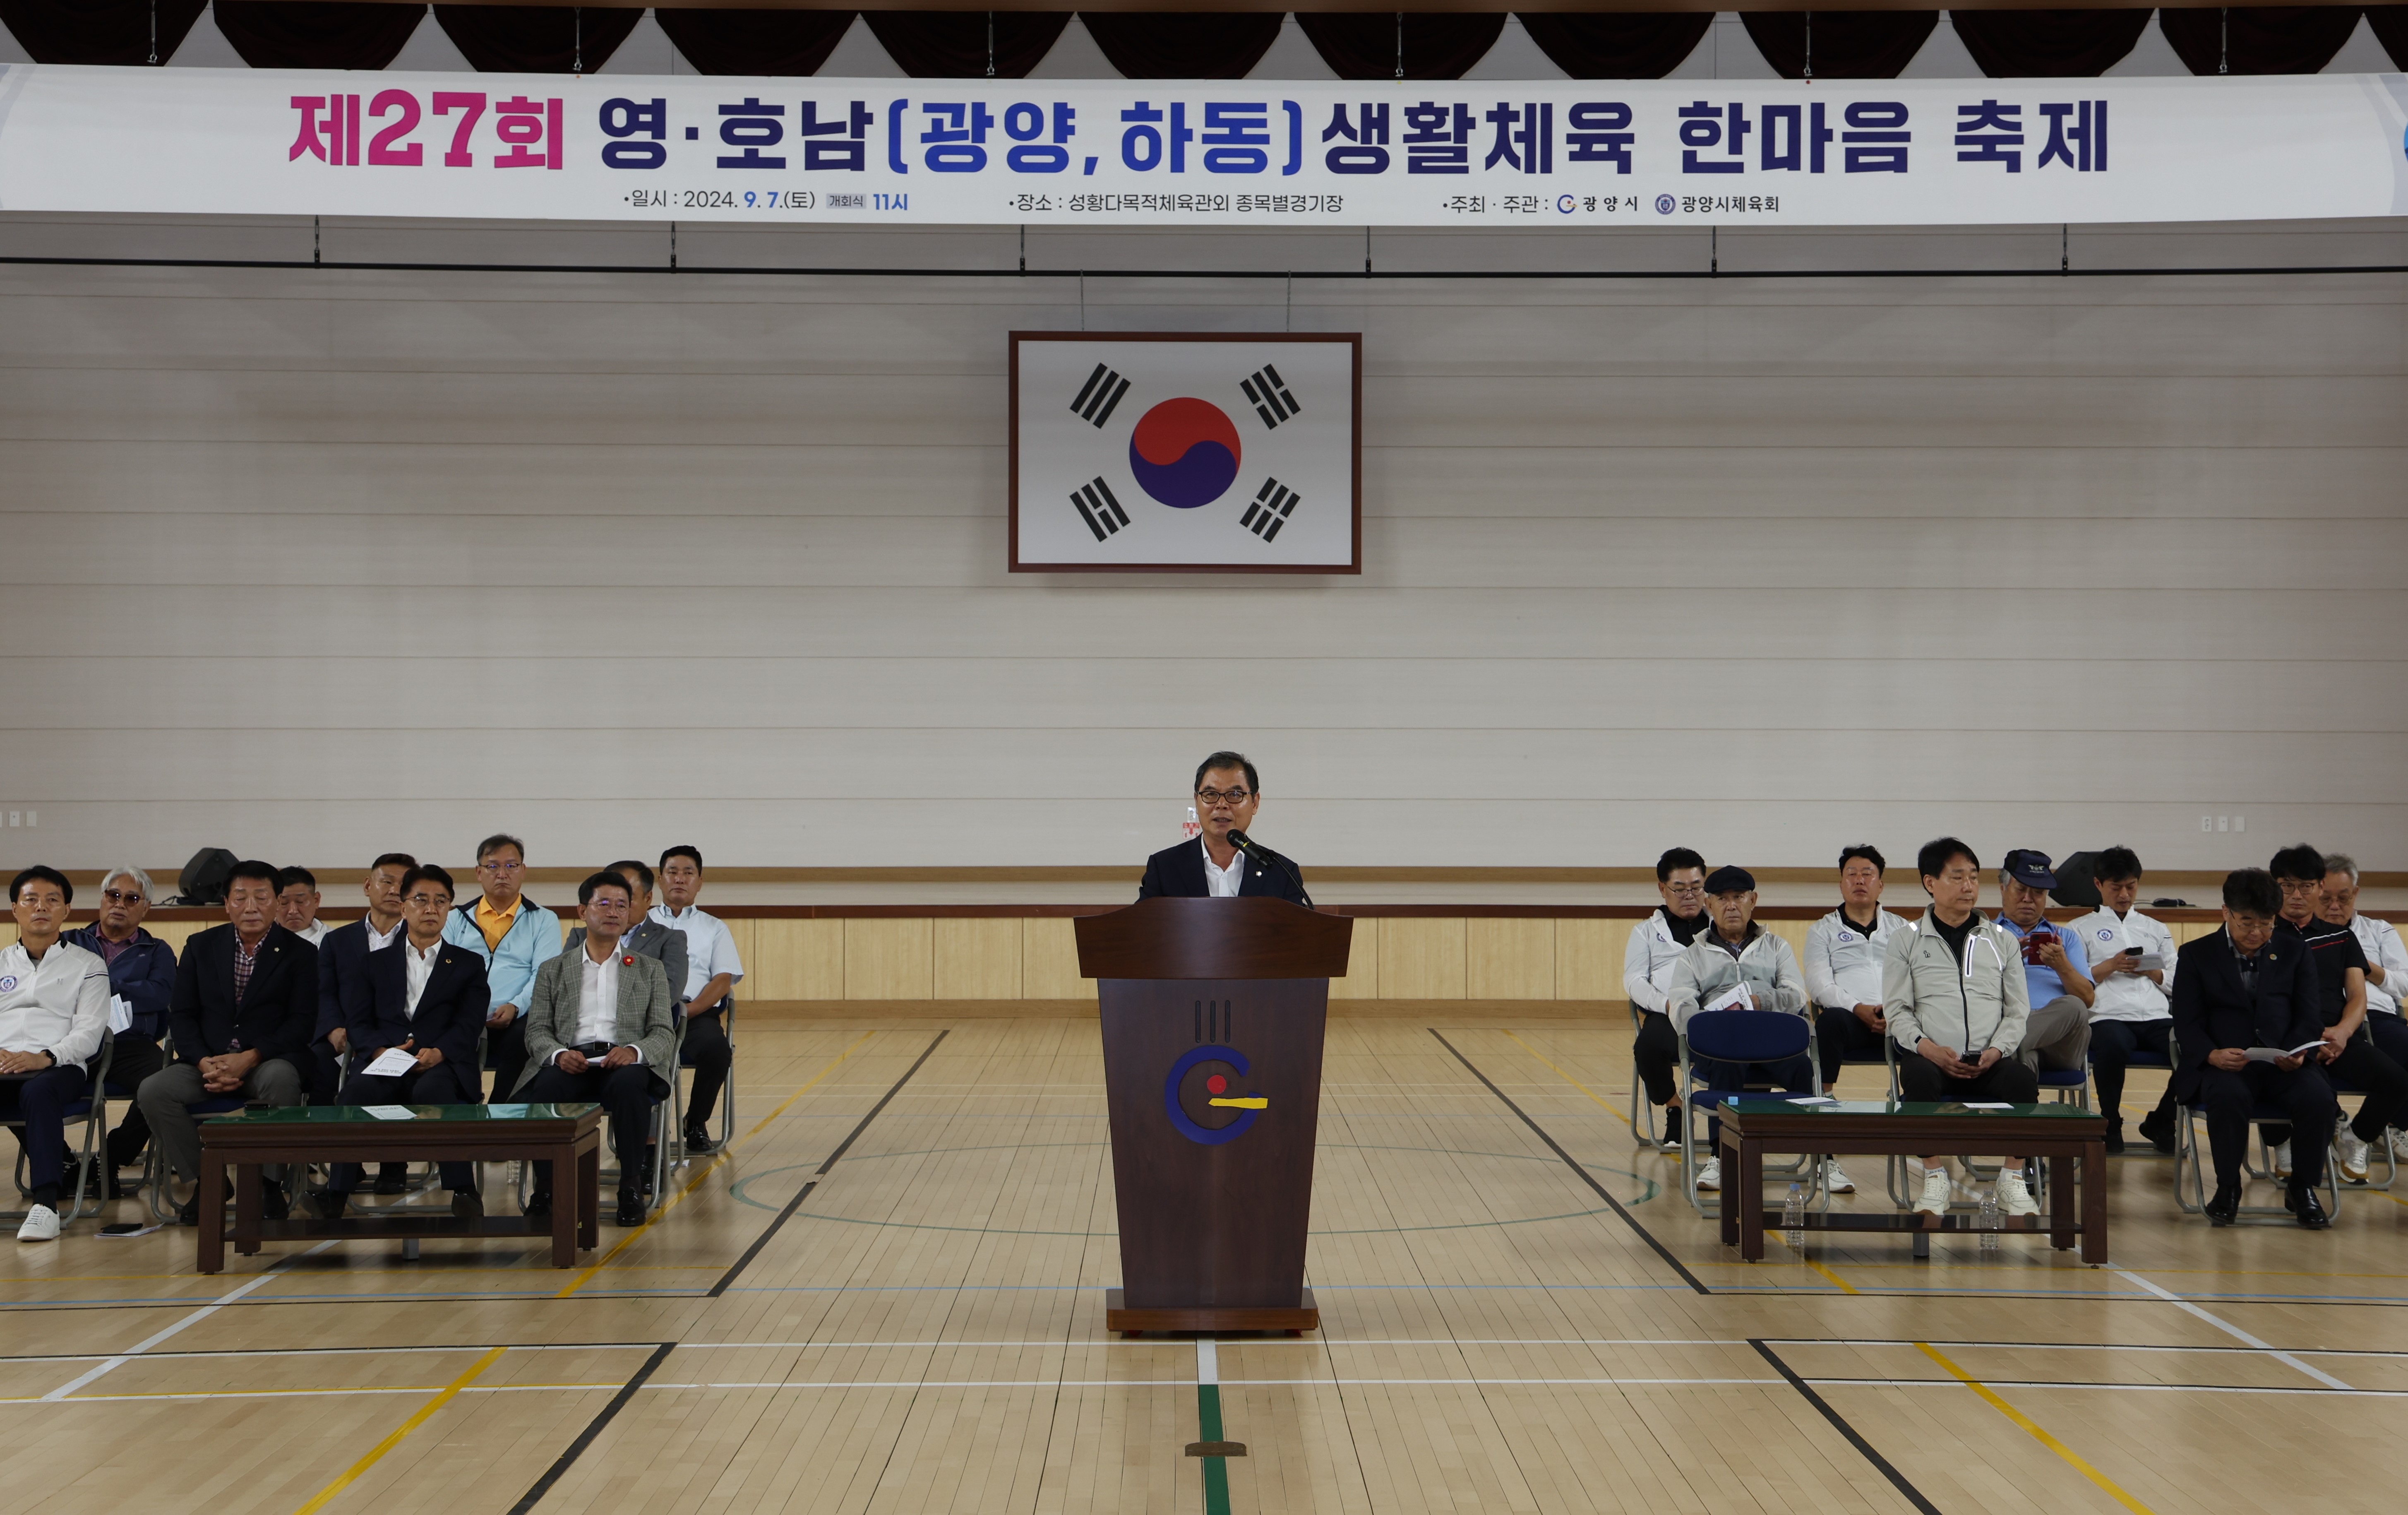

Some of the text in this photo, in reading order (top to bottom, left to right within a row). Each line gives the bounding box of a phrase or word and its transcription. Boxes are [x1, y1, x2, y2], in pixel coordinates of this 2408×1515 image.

[289, 89, 563, 170] 제27회
[1678, 101, 1911, 174] 한마음
[1954, 99, 2108, 173] 축제
[829, 195, 863, 208] 개회식
[873, 193, 908, 211] 11시
[1068, 193, 1229, 212] 성황다목적체육관외
[1236, 195, 1344, 212] 종목별경기장
[1681, 196, 1779, 213] 광양시체육회
